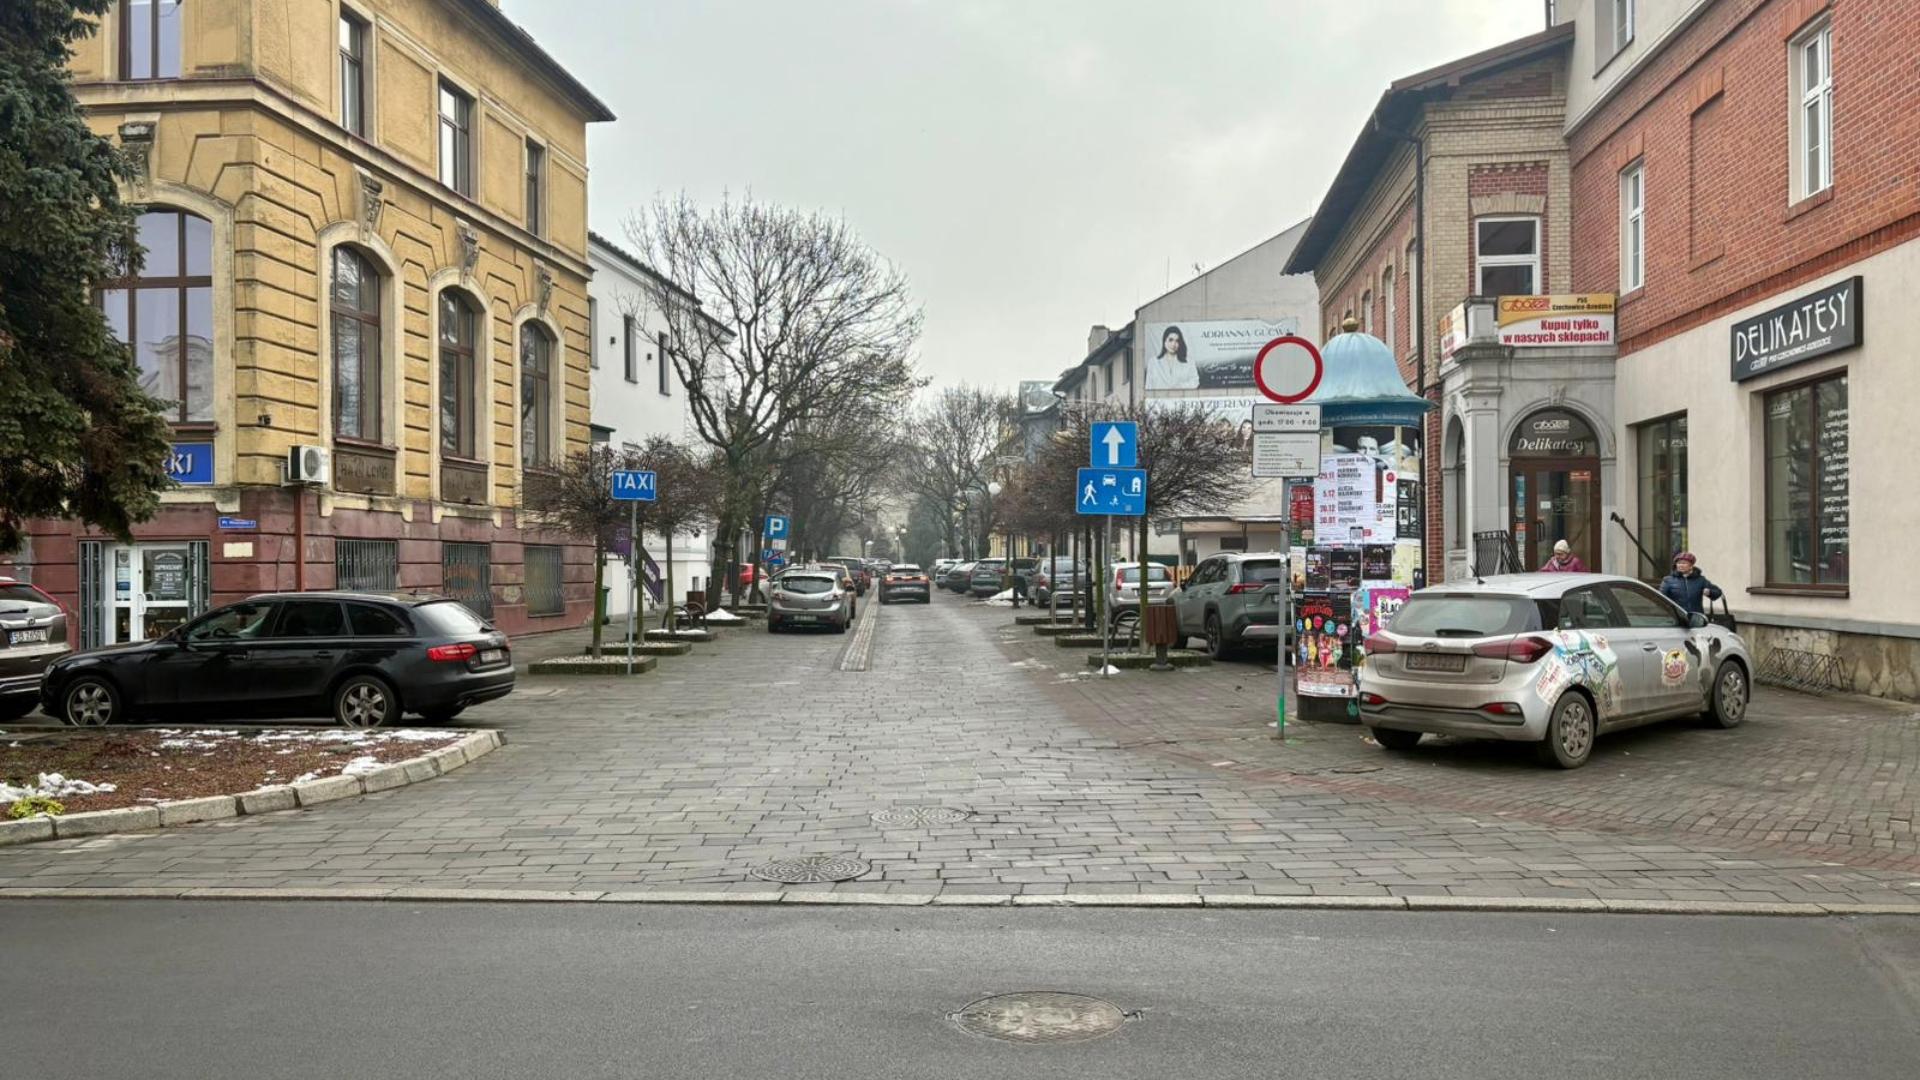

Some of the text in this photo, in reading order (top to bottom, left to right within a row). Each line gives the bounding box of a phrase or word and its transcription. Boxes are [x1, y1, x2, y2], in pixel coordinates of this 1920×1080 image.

[1540, 318, 1599, 331] Kupuj tylko
[1736, 288, 1849, 361] DELIKATESY
[1201, 329, 1250, 338] ADRIANNA
[1503, 330, 1609, 343] w naszych sklepach!
[1517, 438, 1585, 455] Delikatesy
[615, 473, 654, 490] TAXI
[769, 519, 783, 535] P
